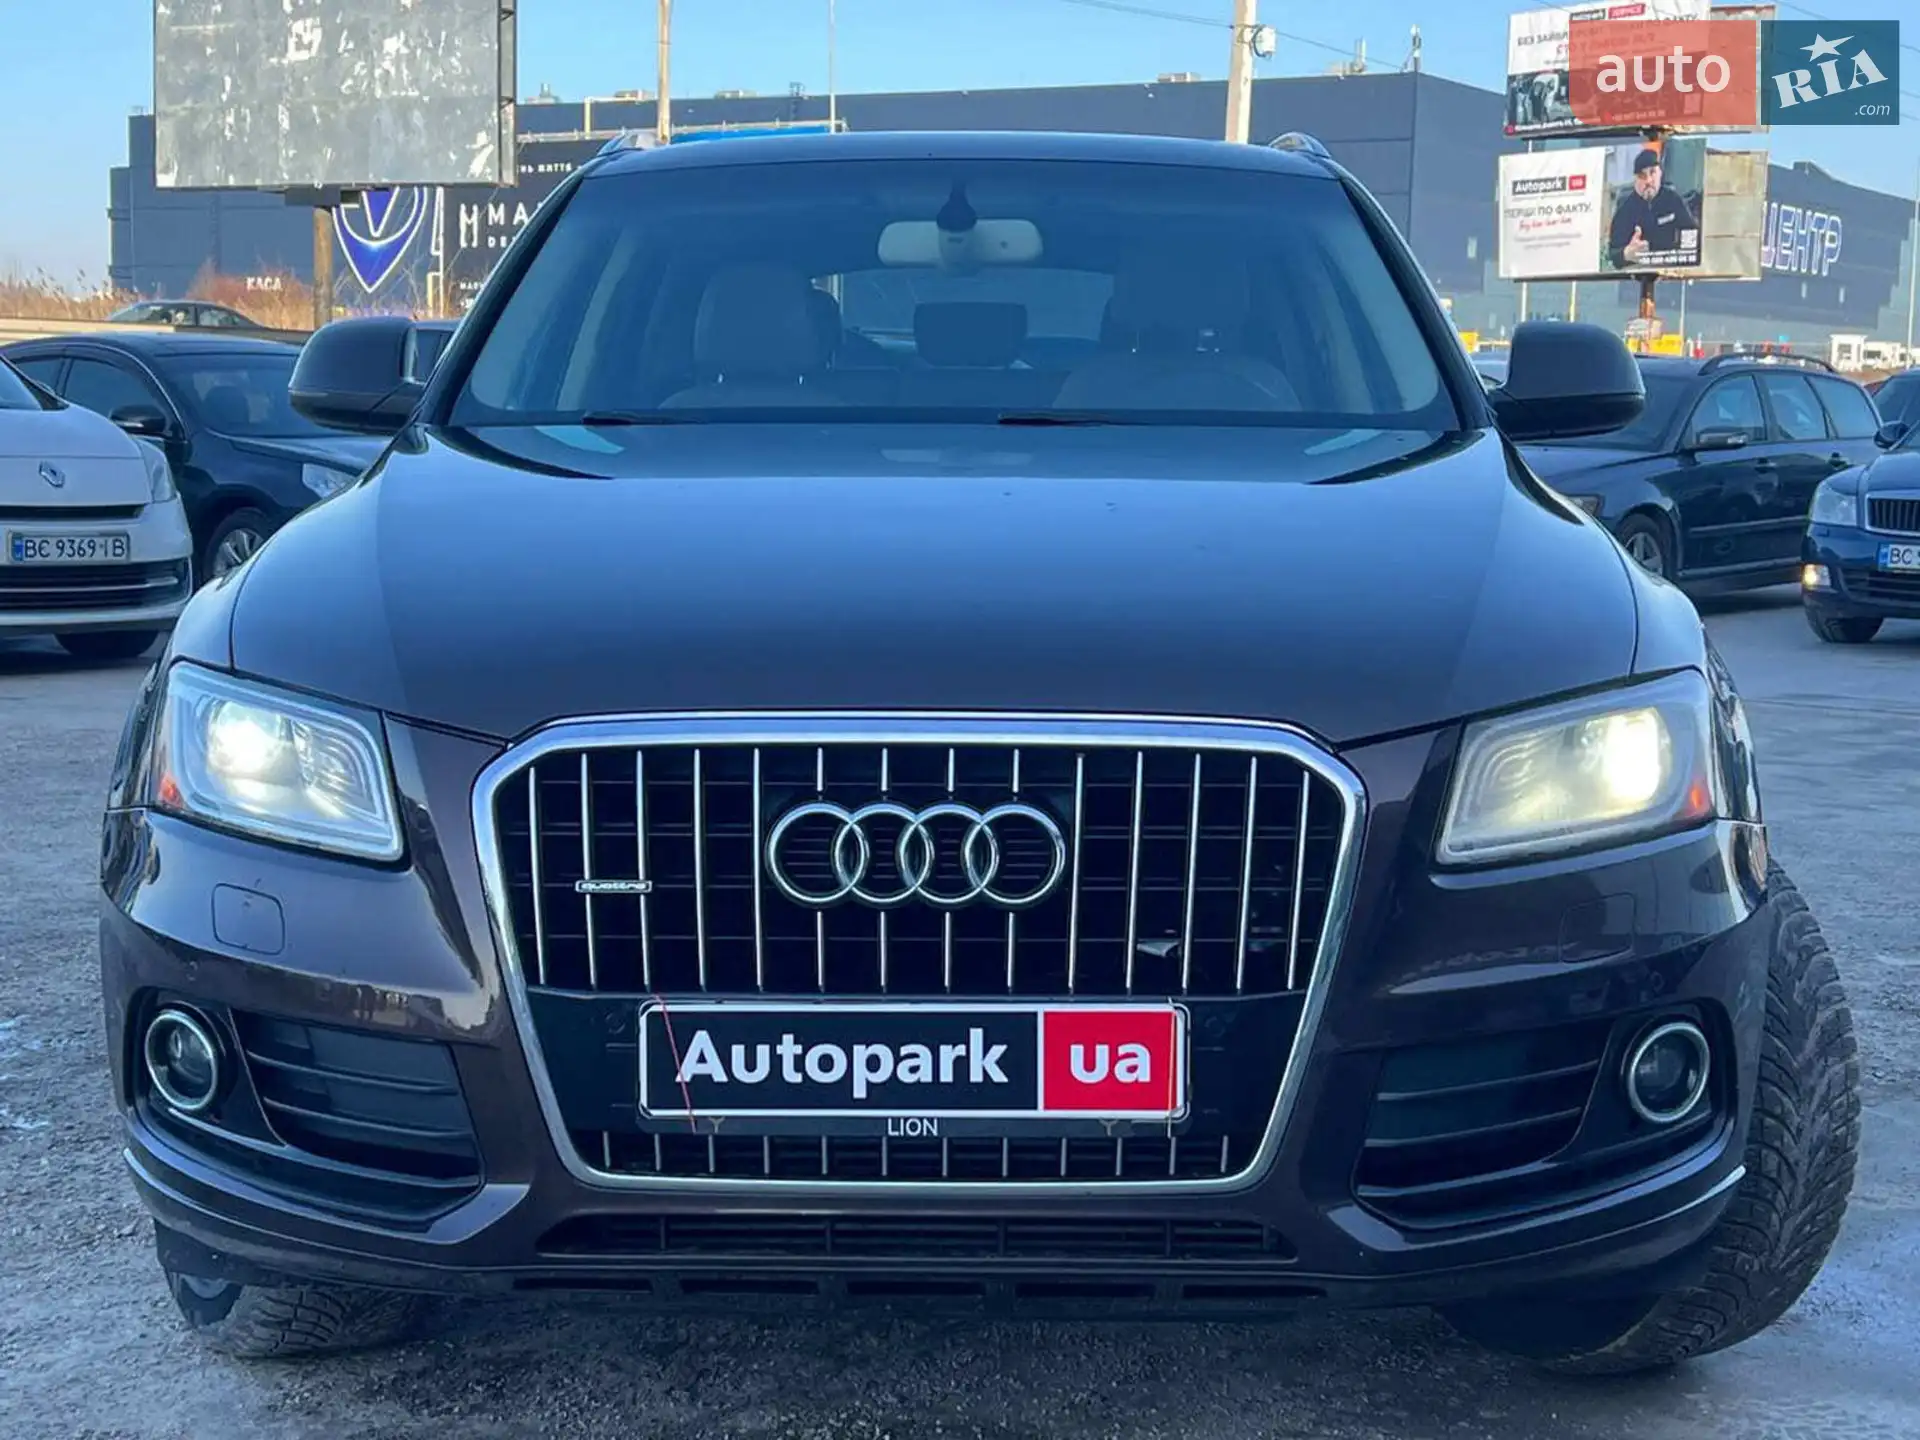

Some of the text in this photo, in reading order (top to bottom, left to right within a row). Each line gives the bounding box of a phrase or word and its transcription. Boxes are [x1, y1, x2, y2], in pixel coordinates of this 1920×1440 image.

[56, 538, 97, 558] 9369
[675, 1027, 1152, 1099] Autopark ua
[887, 1117, 938, 1137] LION
